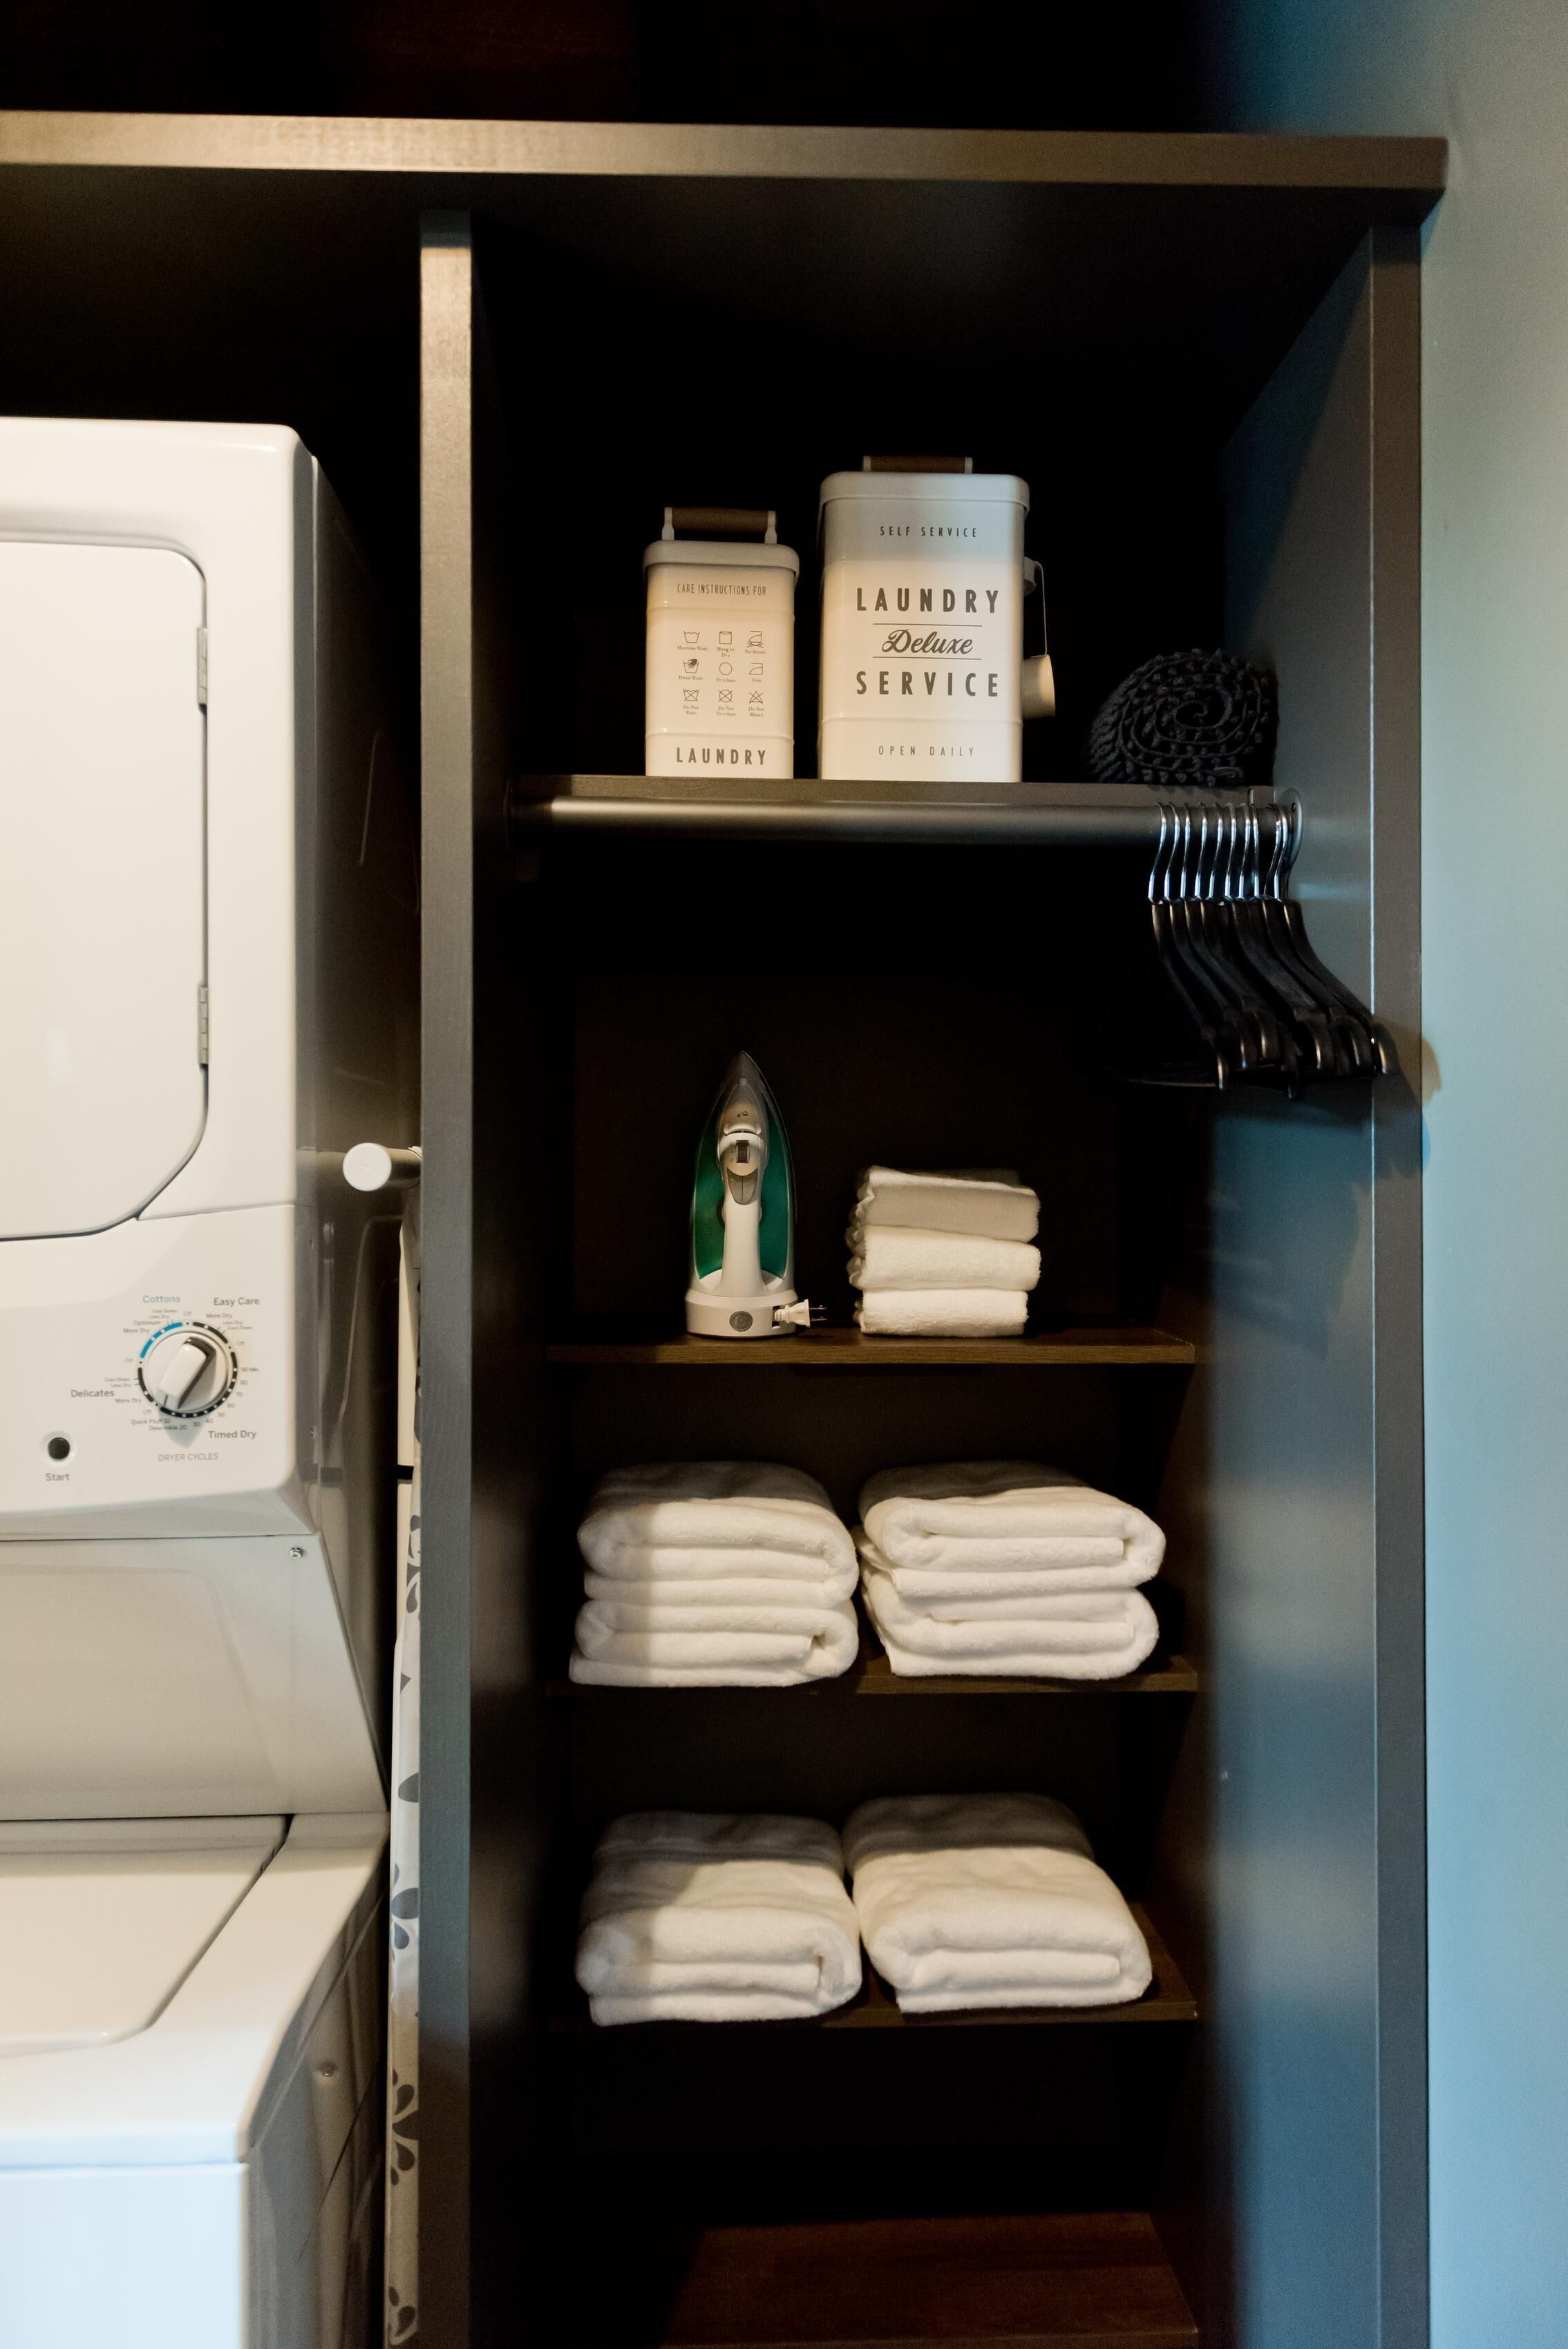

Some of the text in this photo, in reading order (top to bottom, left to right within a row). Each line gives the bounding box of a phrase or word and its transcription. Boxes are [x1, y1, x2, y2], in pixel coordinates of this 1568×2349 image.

[880, 526, 977, 538] SELF SERVICE
[677, 583, 766, 596] CARE INSTRUCTIONS FOR
[857, 587, 999, 614] LAUNDRY
[881, 628, 974, 654] Deluxe
[856, 670, 999, 697] SERVICE
[677, 747, 766, 765] LAUNDRY
[878, 746, 974, 756] OPEN DAILY
[142, 1295, 181, 1303] Cottons
[214, 1297, 236, 1307] Easy
[70, 1389, 115, 1397] Delicates
[208, 1430, 257, 1439] Timed Dry
[45, 1473, 70, 1481] Start
